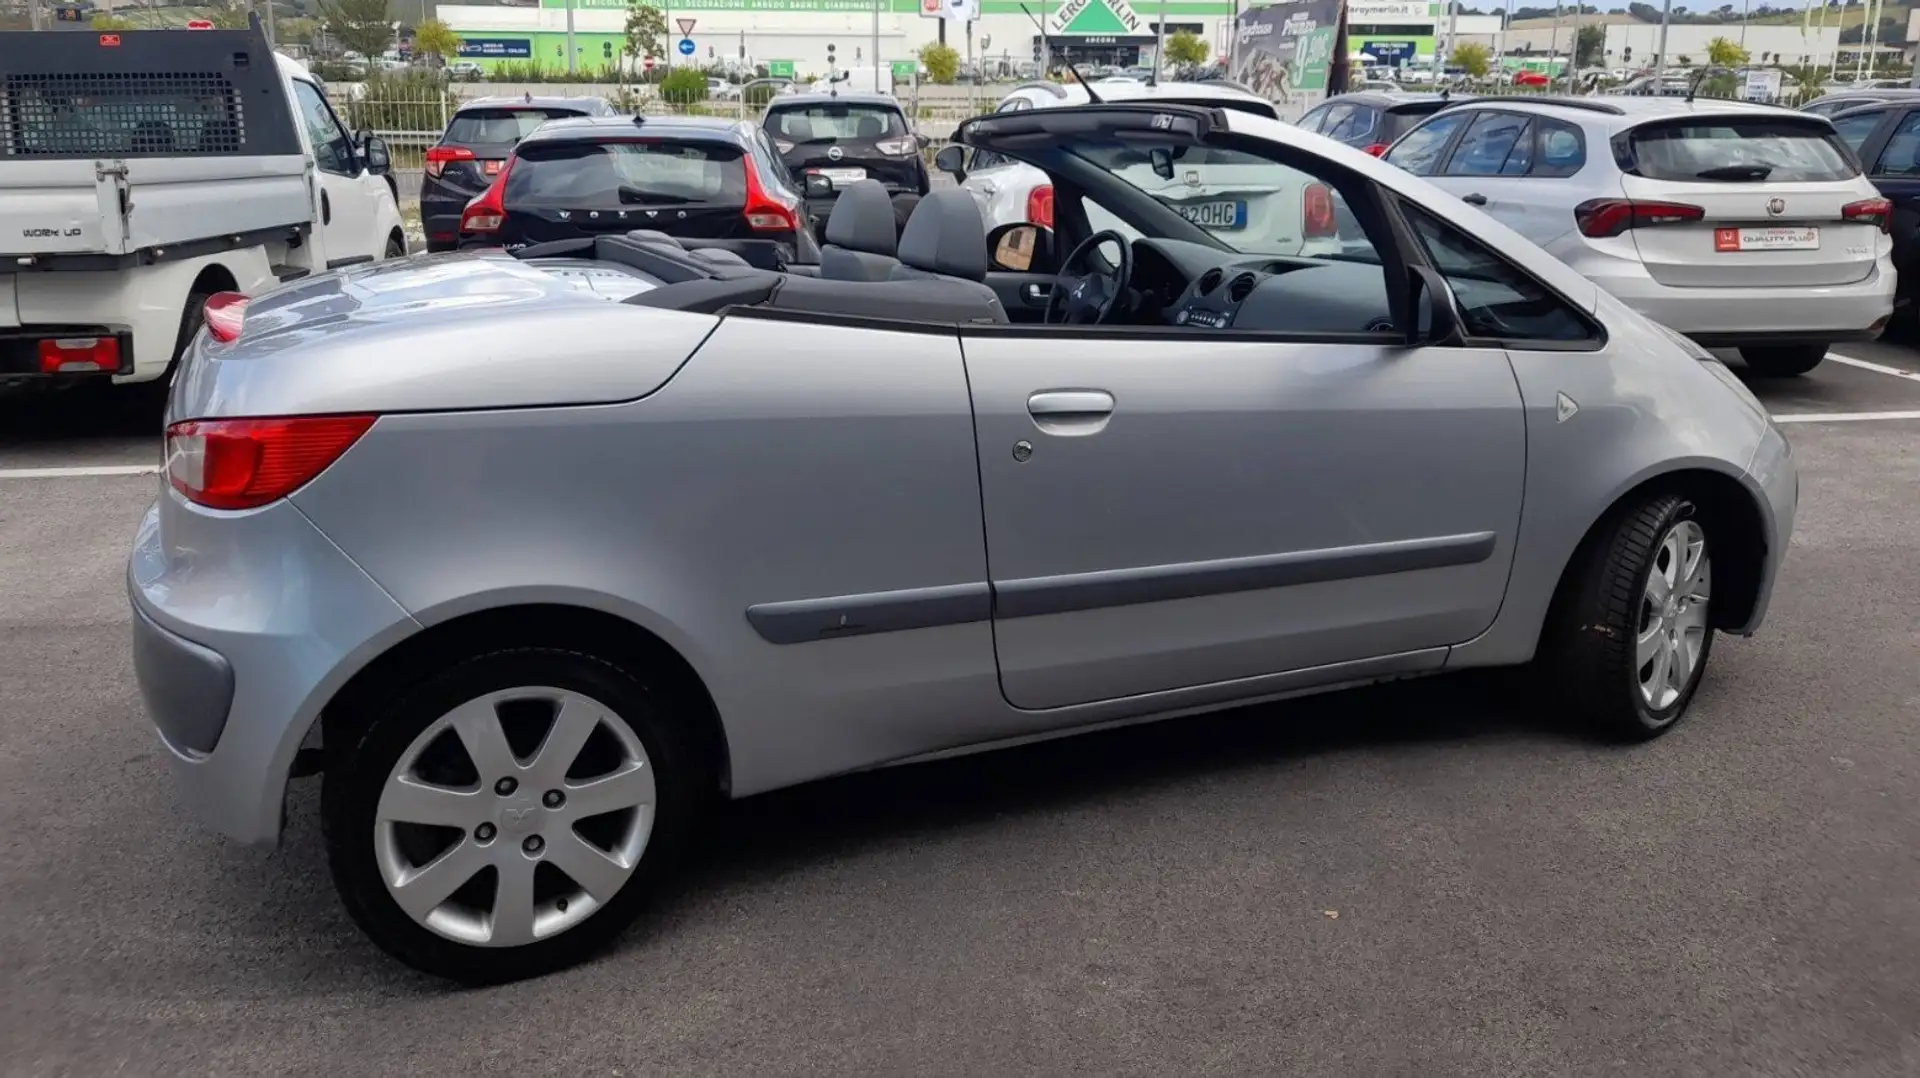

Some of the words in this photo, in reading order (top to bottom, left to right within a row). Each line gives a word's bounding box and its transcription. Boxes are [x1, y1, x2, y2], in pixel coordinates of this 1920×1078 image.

[824, 1, 886, 10] GIARDINAGGO
[560, 211, 687, 219] VOLVO
[23, 228, 59, 237] WORK
[64, 228, 82, 236] UP
